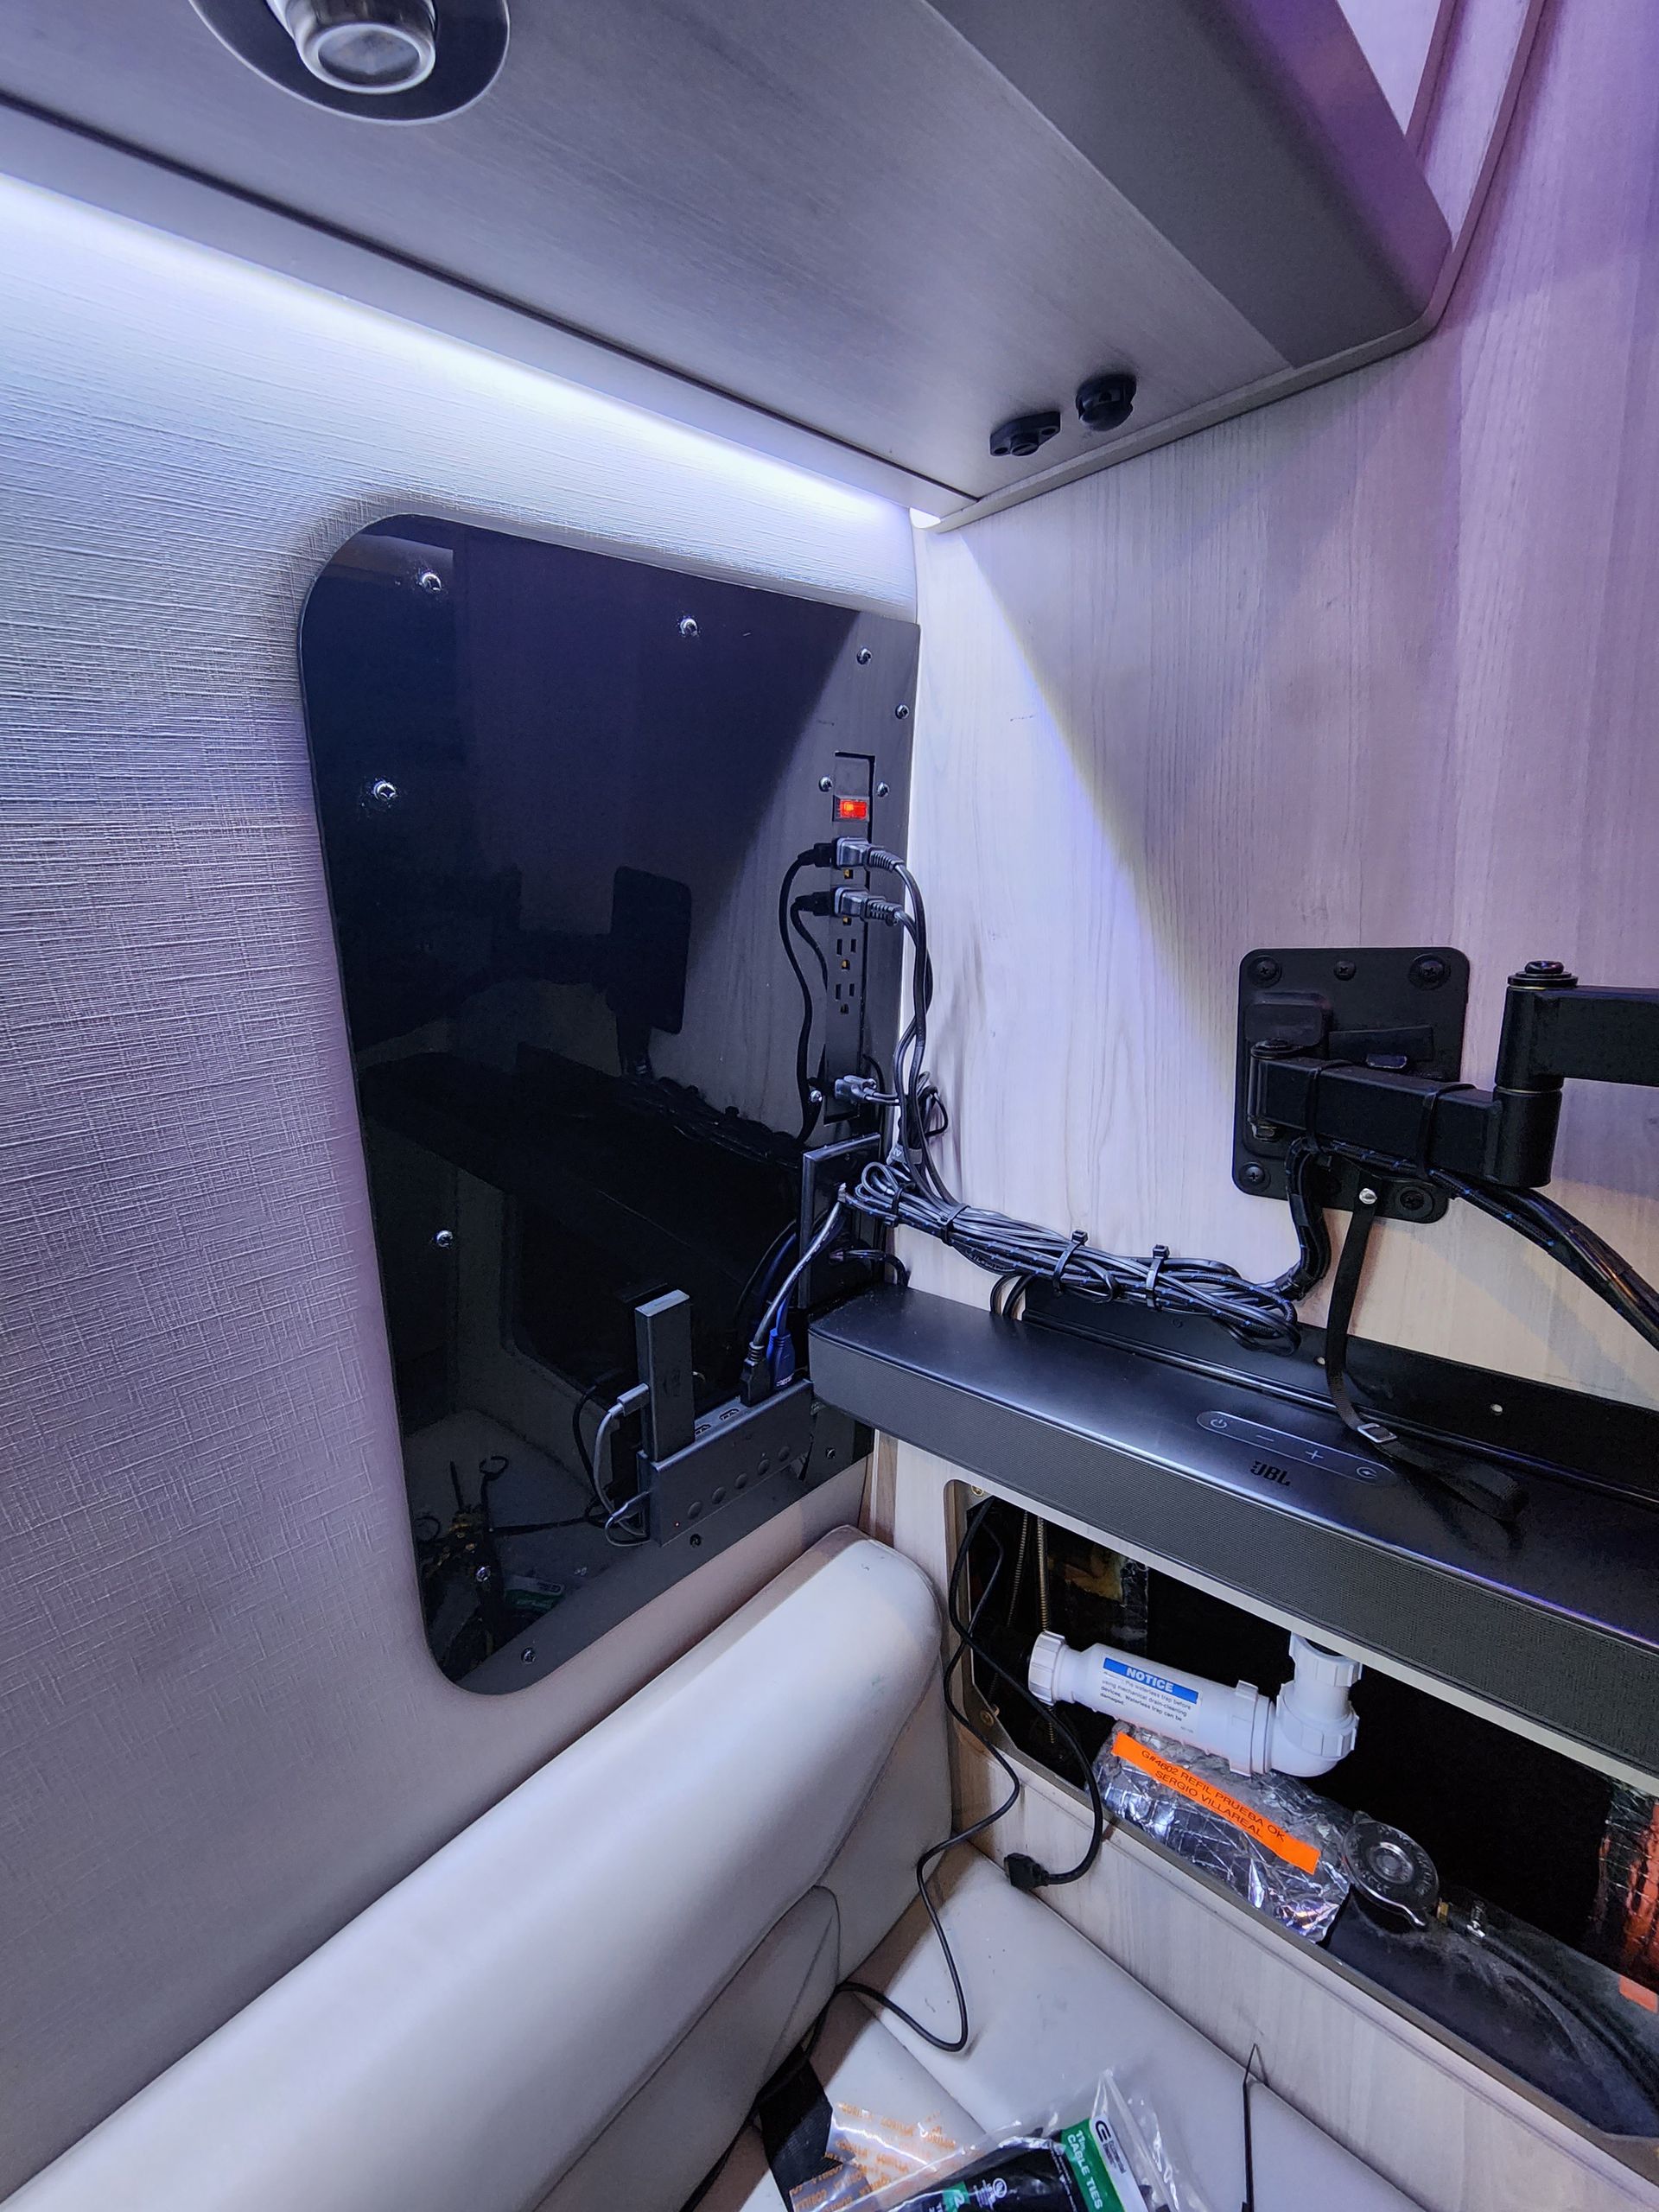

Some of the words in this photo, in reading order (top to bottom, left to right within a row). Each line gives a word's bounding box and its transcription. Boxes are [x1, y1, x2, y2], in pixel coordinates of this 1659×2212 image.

[1250, 1460, 1291, 1486] JBL
[1126, 1667, 1175, 1694] NOTICE
[1141, 1750, 1179, 1775] G#4602
[1180, 1770, 1212, 1794] REFIL
[1214, 1791, 1264, 1827] PRUEBA
[1267, 1823, 1286, 1842] OK
[1154, 1770, 1198, 1797] SERGIO
[1201, 1796, 1262, 1839] VILLAREAL
[1067, 2133, 1090, 2177] CABLE
[1085, 2176, 1103, 2210] TIES
